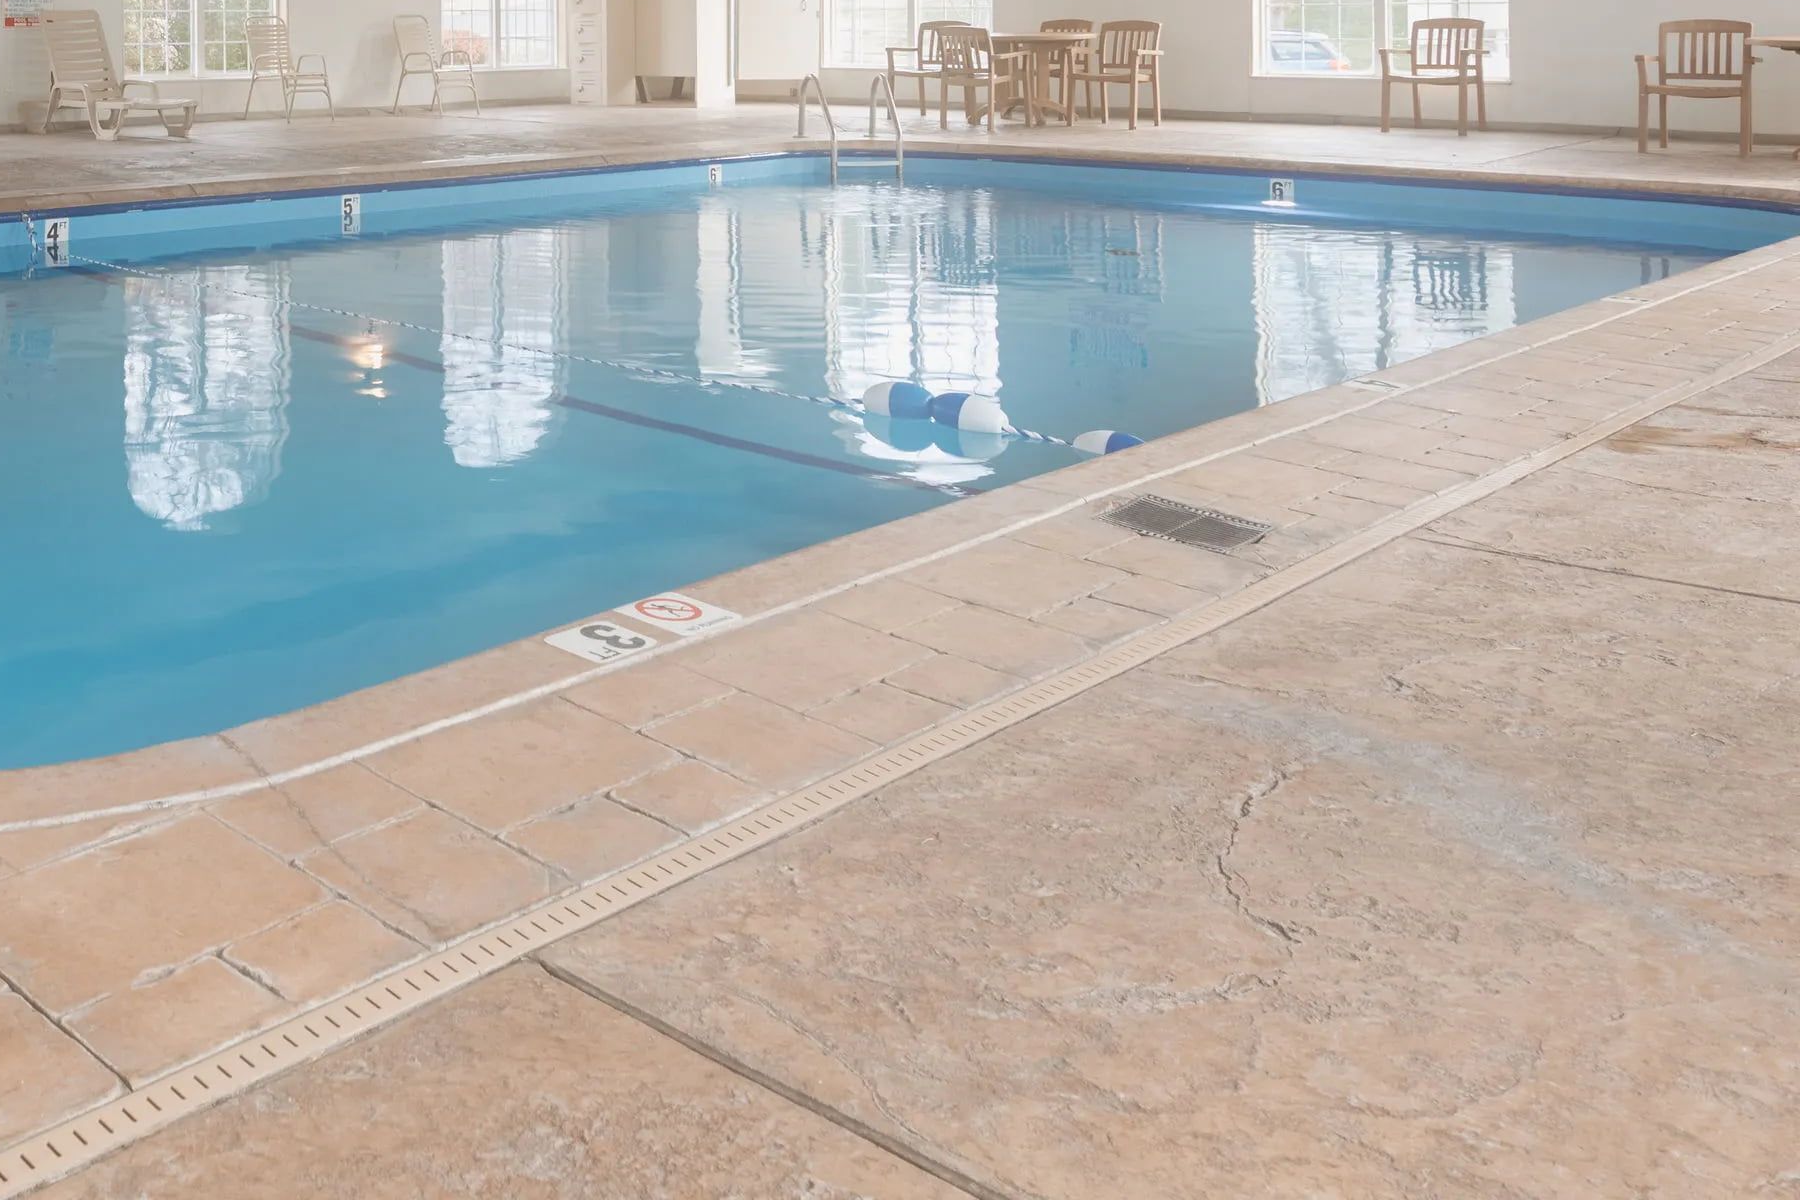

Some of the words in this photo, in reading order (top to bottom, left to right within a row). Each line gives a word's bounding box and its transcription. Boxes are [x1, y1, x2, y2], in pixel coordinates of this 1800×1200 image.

[711, 168, 716, 181] 6
[1272, 181, 1283, 198] 6
[344, 198, 352, 215] 5
[47, 222, 59, 241] 4
[580, 624, 646, 650] 3
[589, 646, 621, 661] FT
